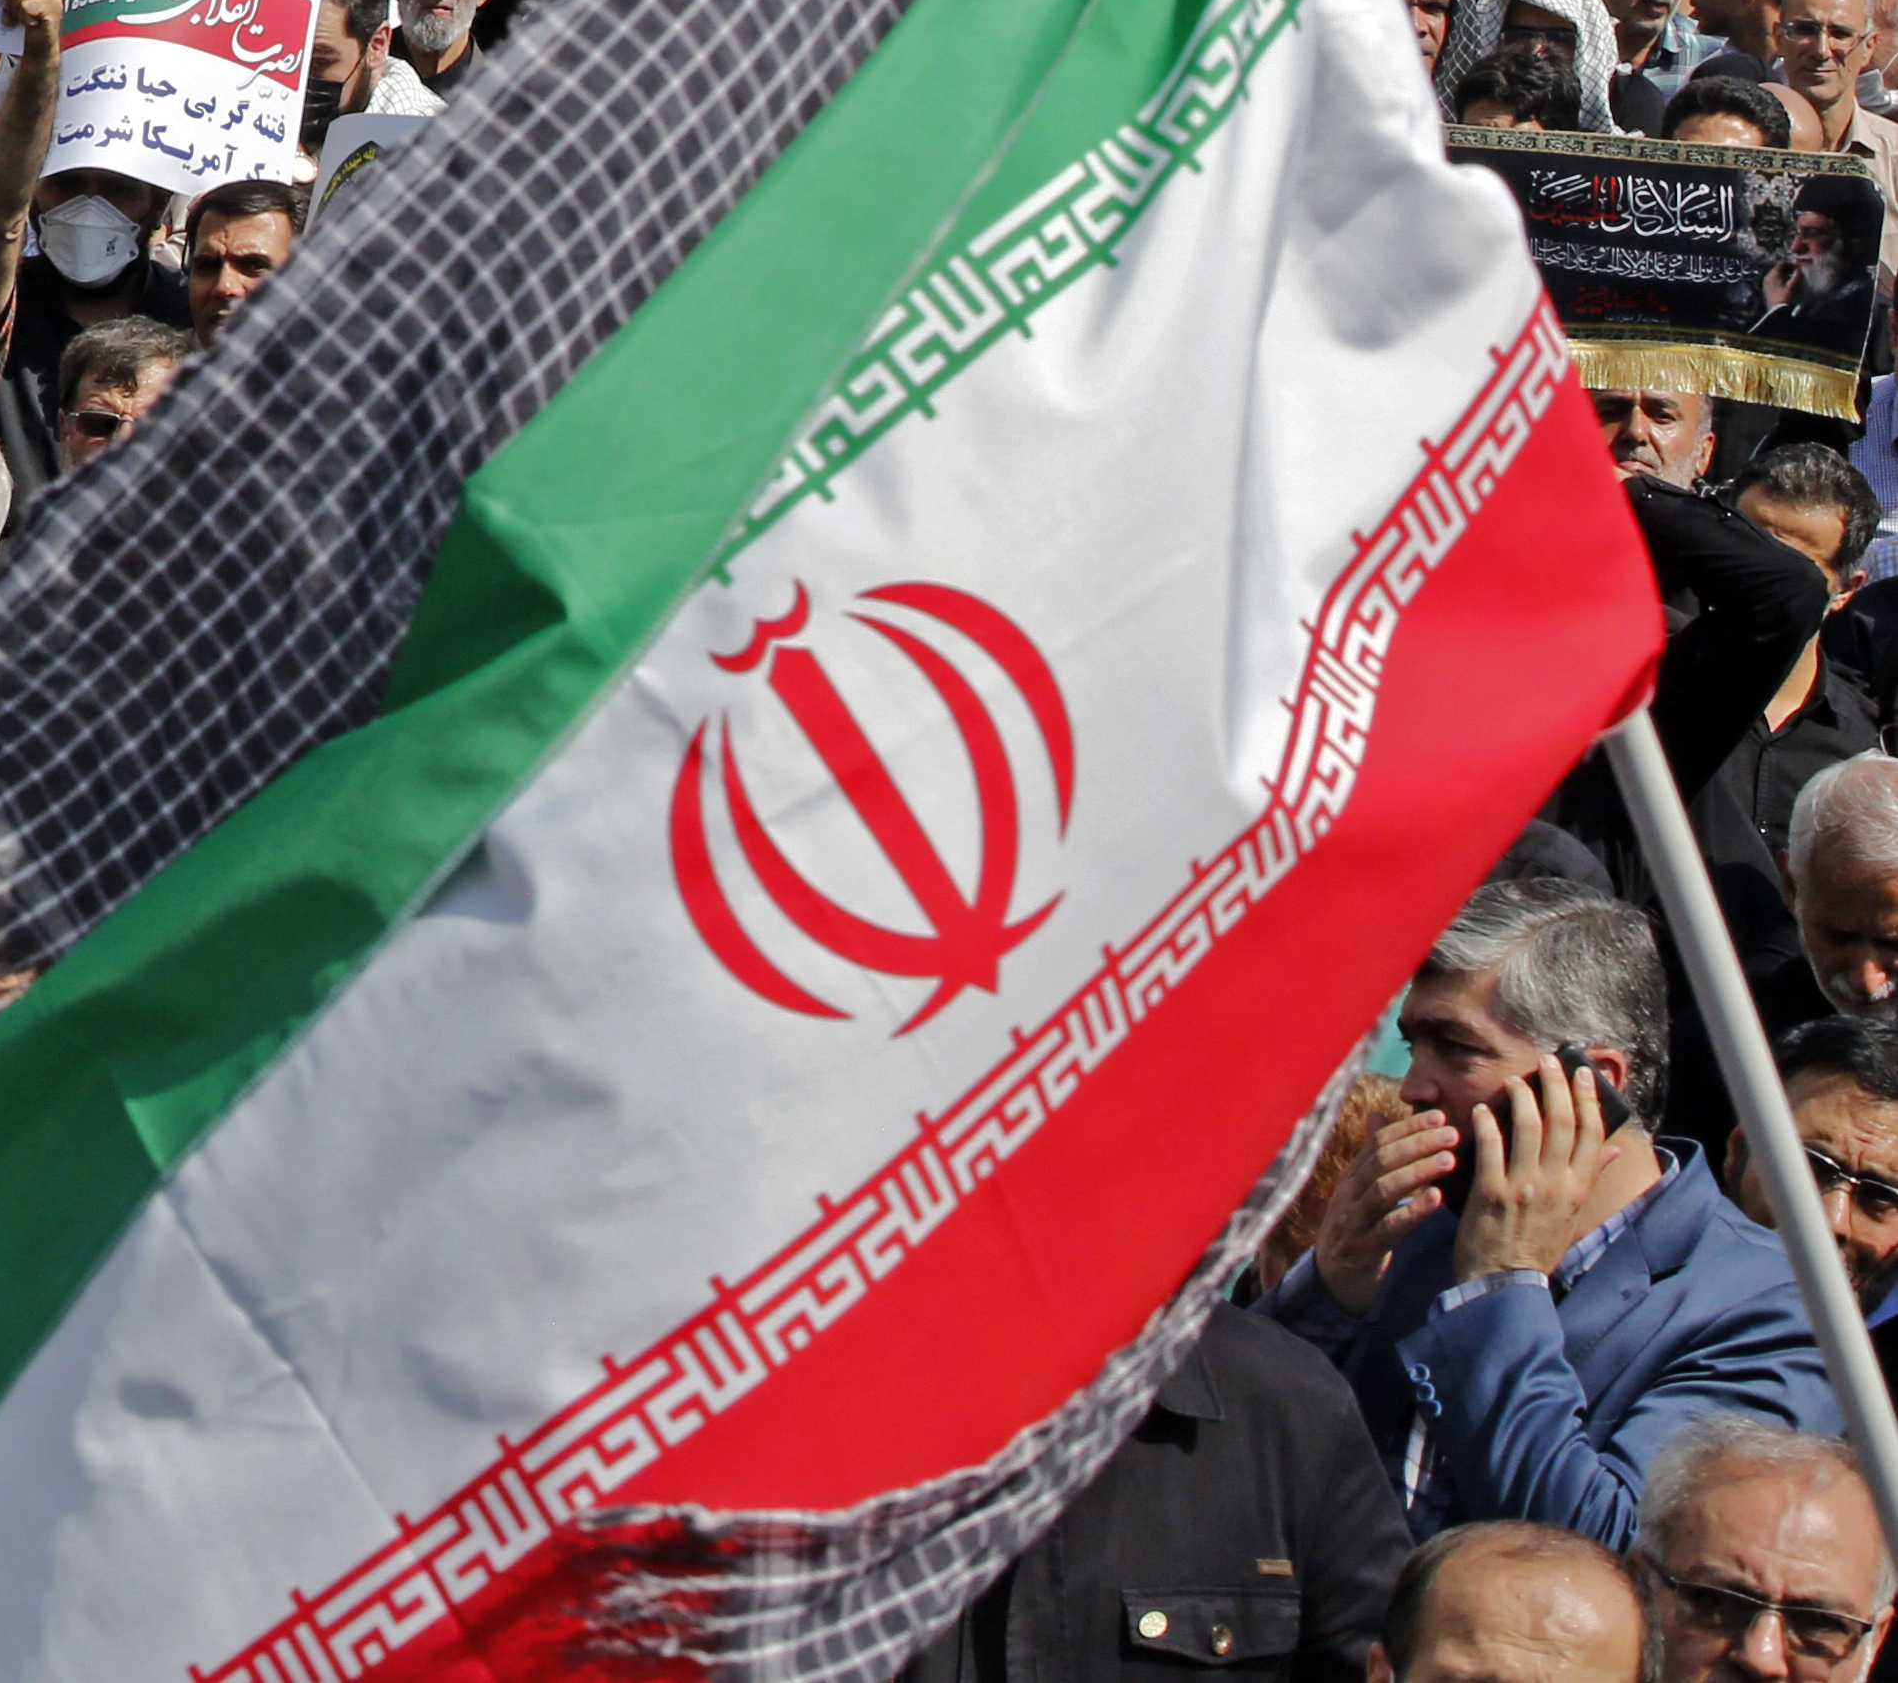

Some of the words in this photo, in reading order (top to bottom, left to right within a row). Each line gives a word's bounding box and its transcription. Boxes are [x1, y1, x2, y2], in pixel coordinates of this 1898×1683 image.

[66, 64, 128, 97] ننگت
[137, 67, 177, 102] حیا
[184, 95, 217, 124] بی
[221, 101, 250, 130] گر
[254, 113, 286, 144] فتنه
[142, 120, 238, 175] آمریکا
